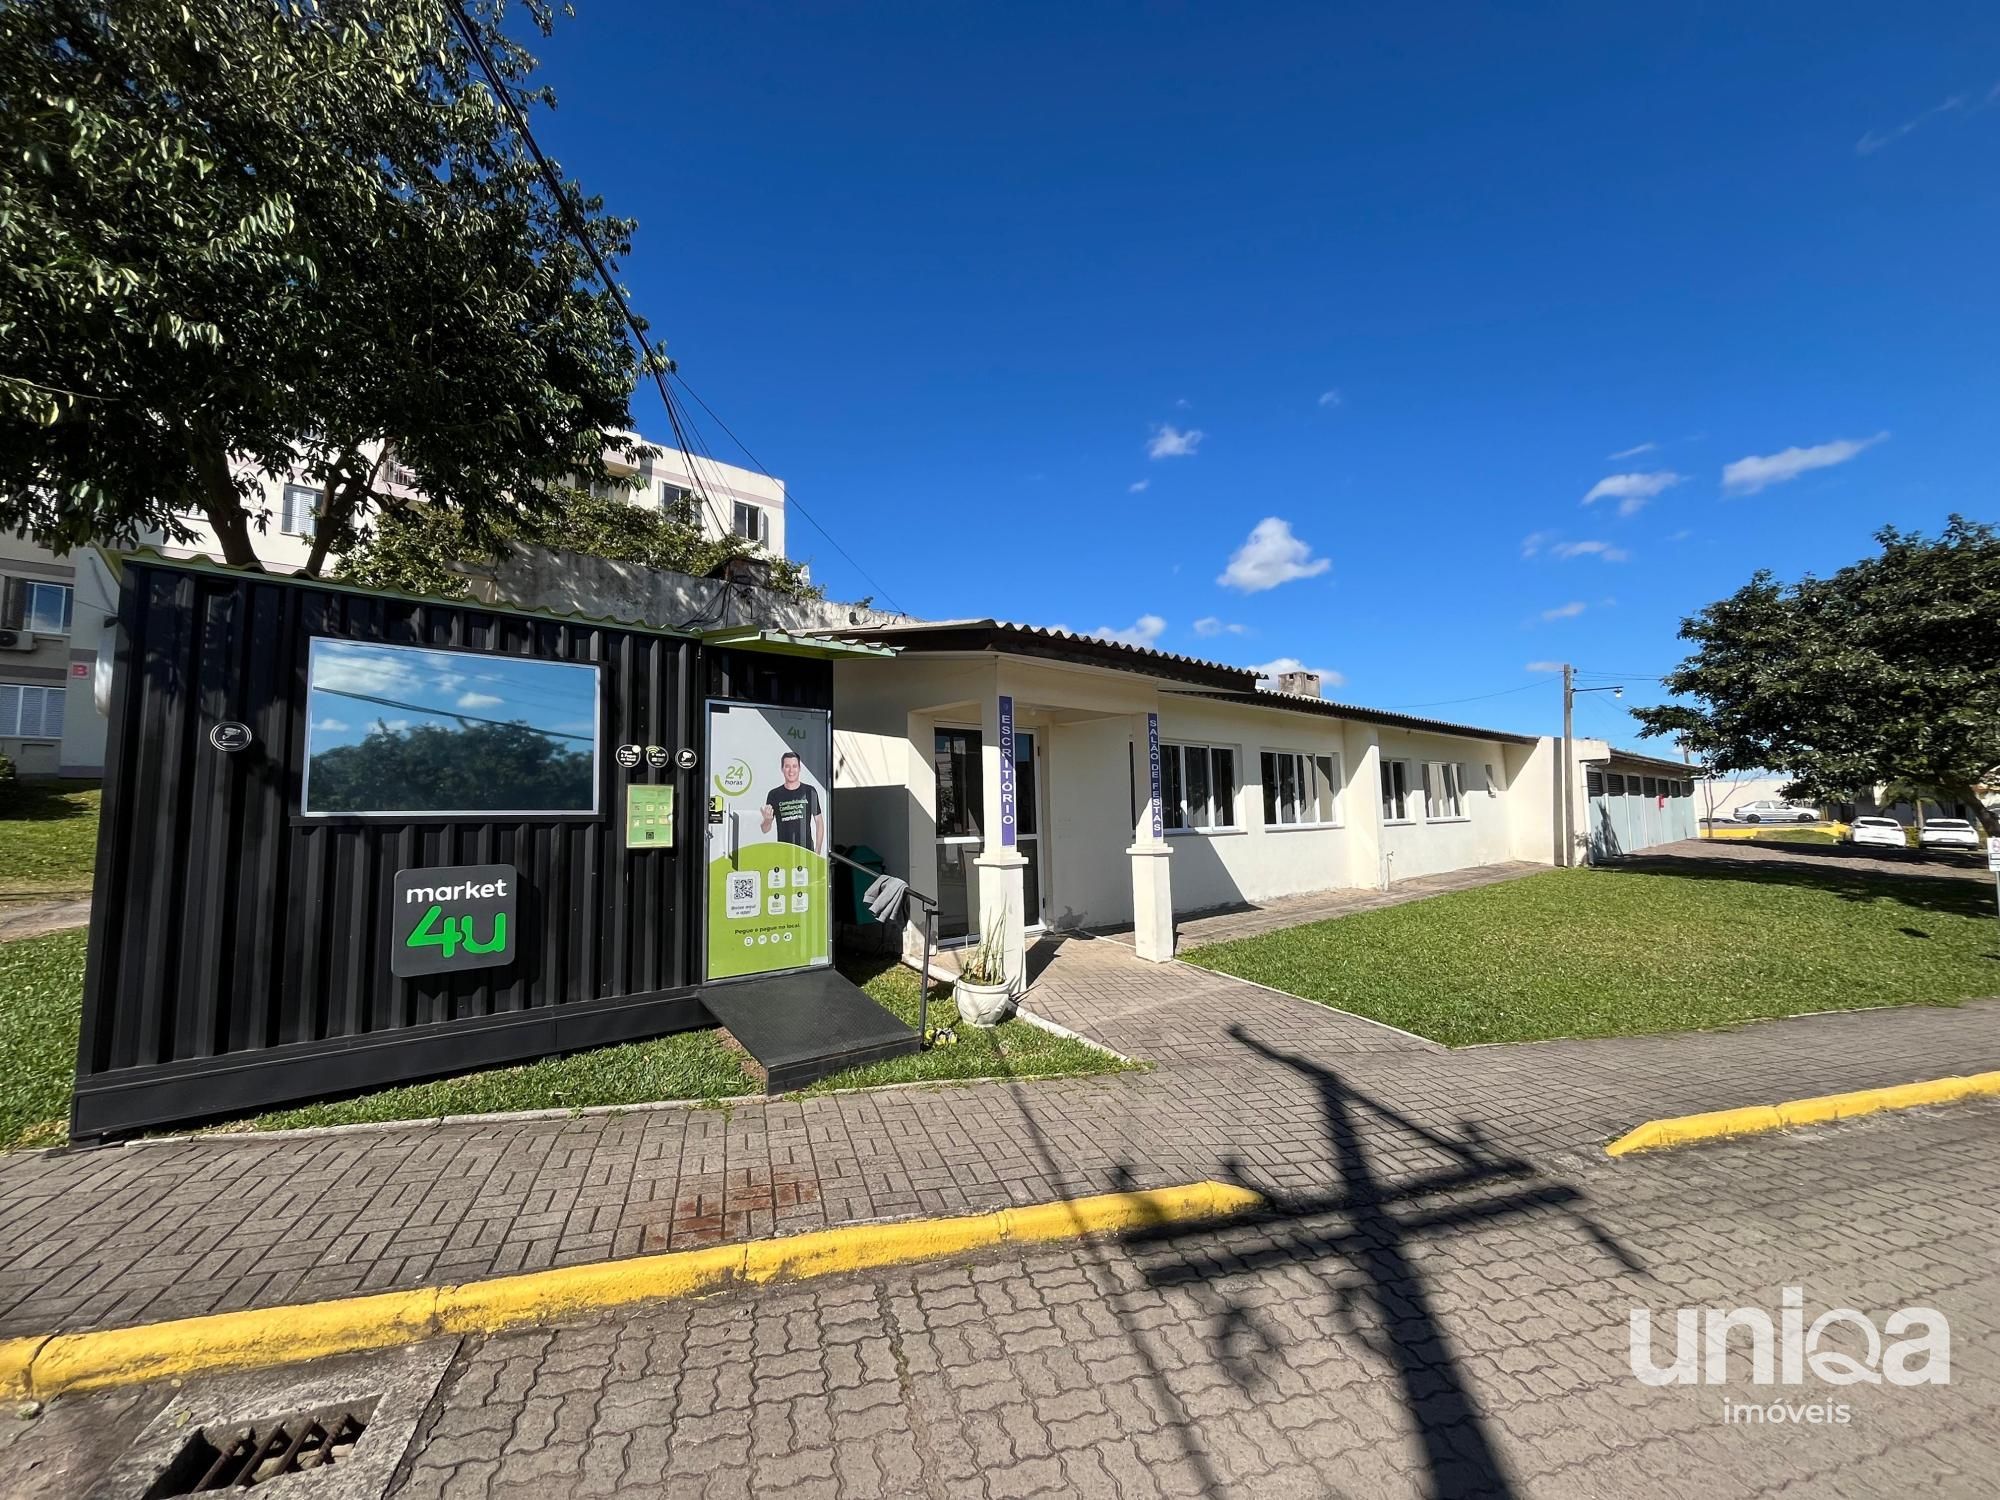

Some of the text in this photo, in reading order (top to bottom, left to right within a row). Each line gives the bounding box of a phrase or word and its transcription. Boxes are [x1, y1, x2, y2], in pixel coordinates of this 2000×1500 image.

[725, 766, 744, 780] 24
[1001, 715, 1014, 825] ESCRITÓRIO
[1149, 720, 1161, 831] SALÃO DE FESTAS
[406, 879, 508, 904] market
